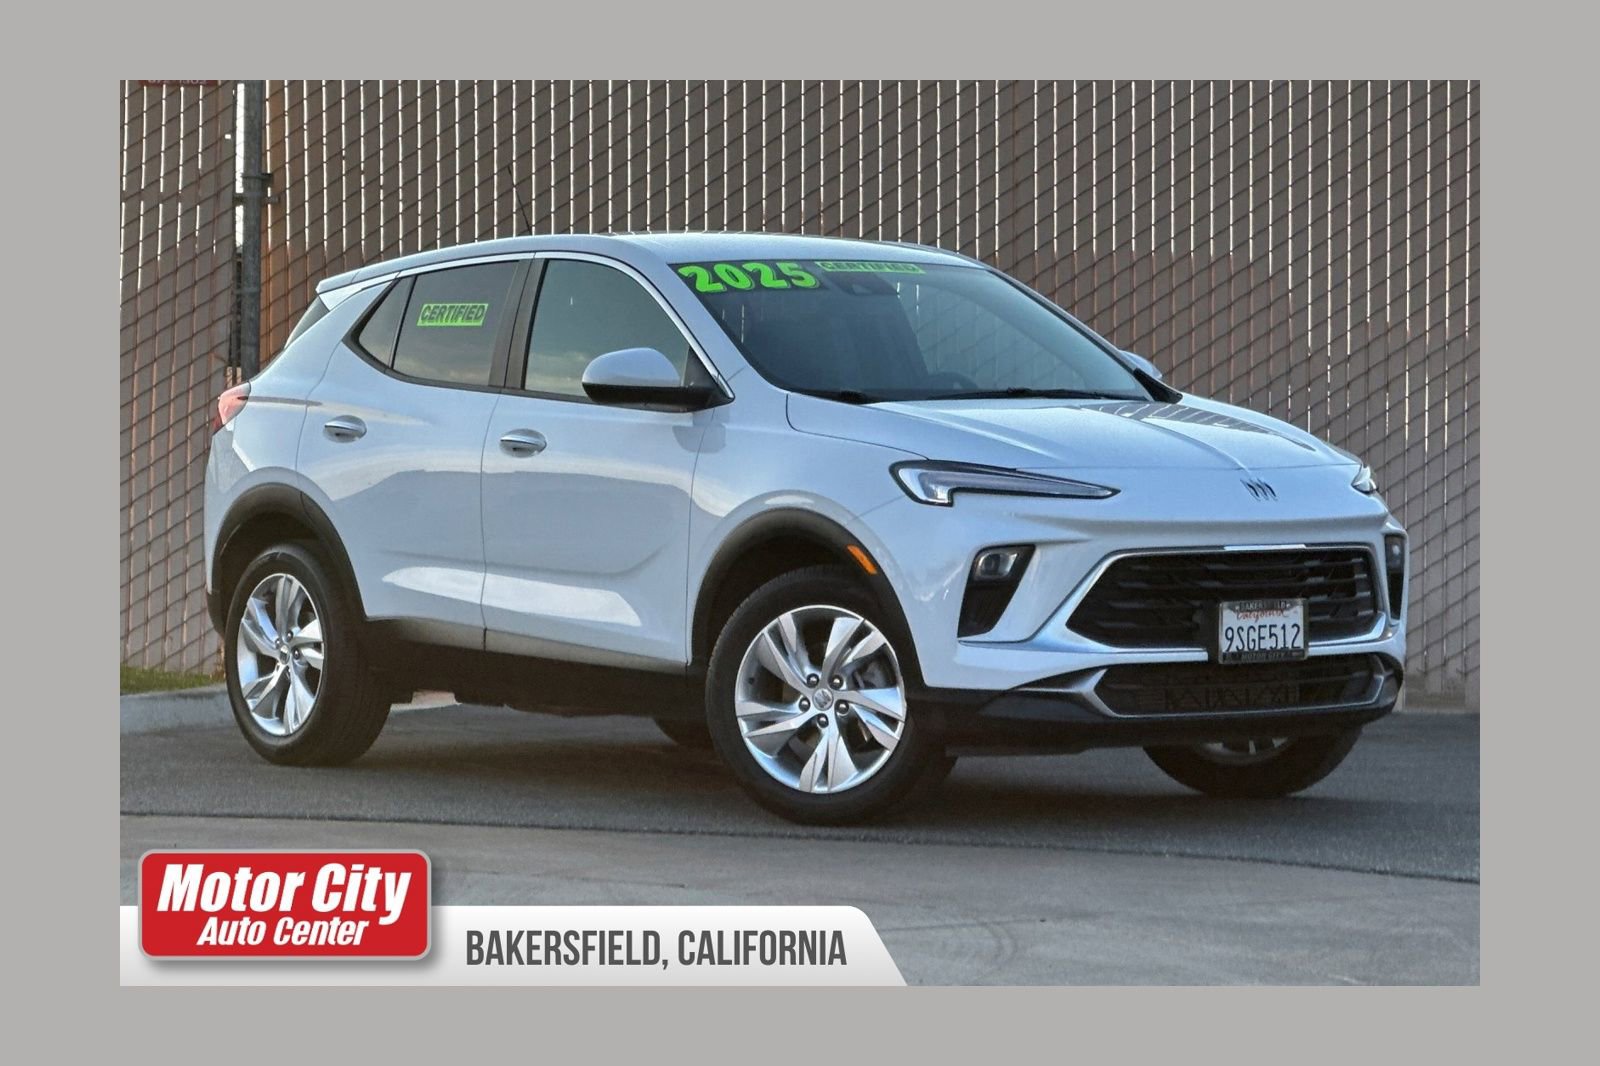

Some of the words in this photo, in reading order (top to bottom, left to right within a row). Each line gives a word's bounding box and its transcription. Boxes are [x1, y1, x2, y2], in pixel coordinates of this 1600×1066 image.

[678, 262, 819, 293] 2025
[420, 304, 486, 323] CERTIFIED
[1224, 623, 1302, 652] 9SGE512
